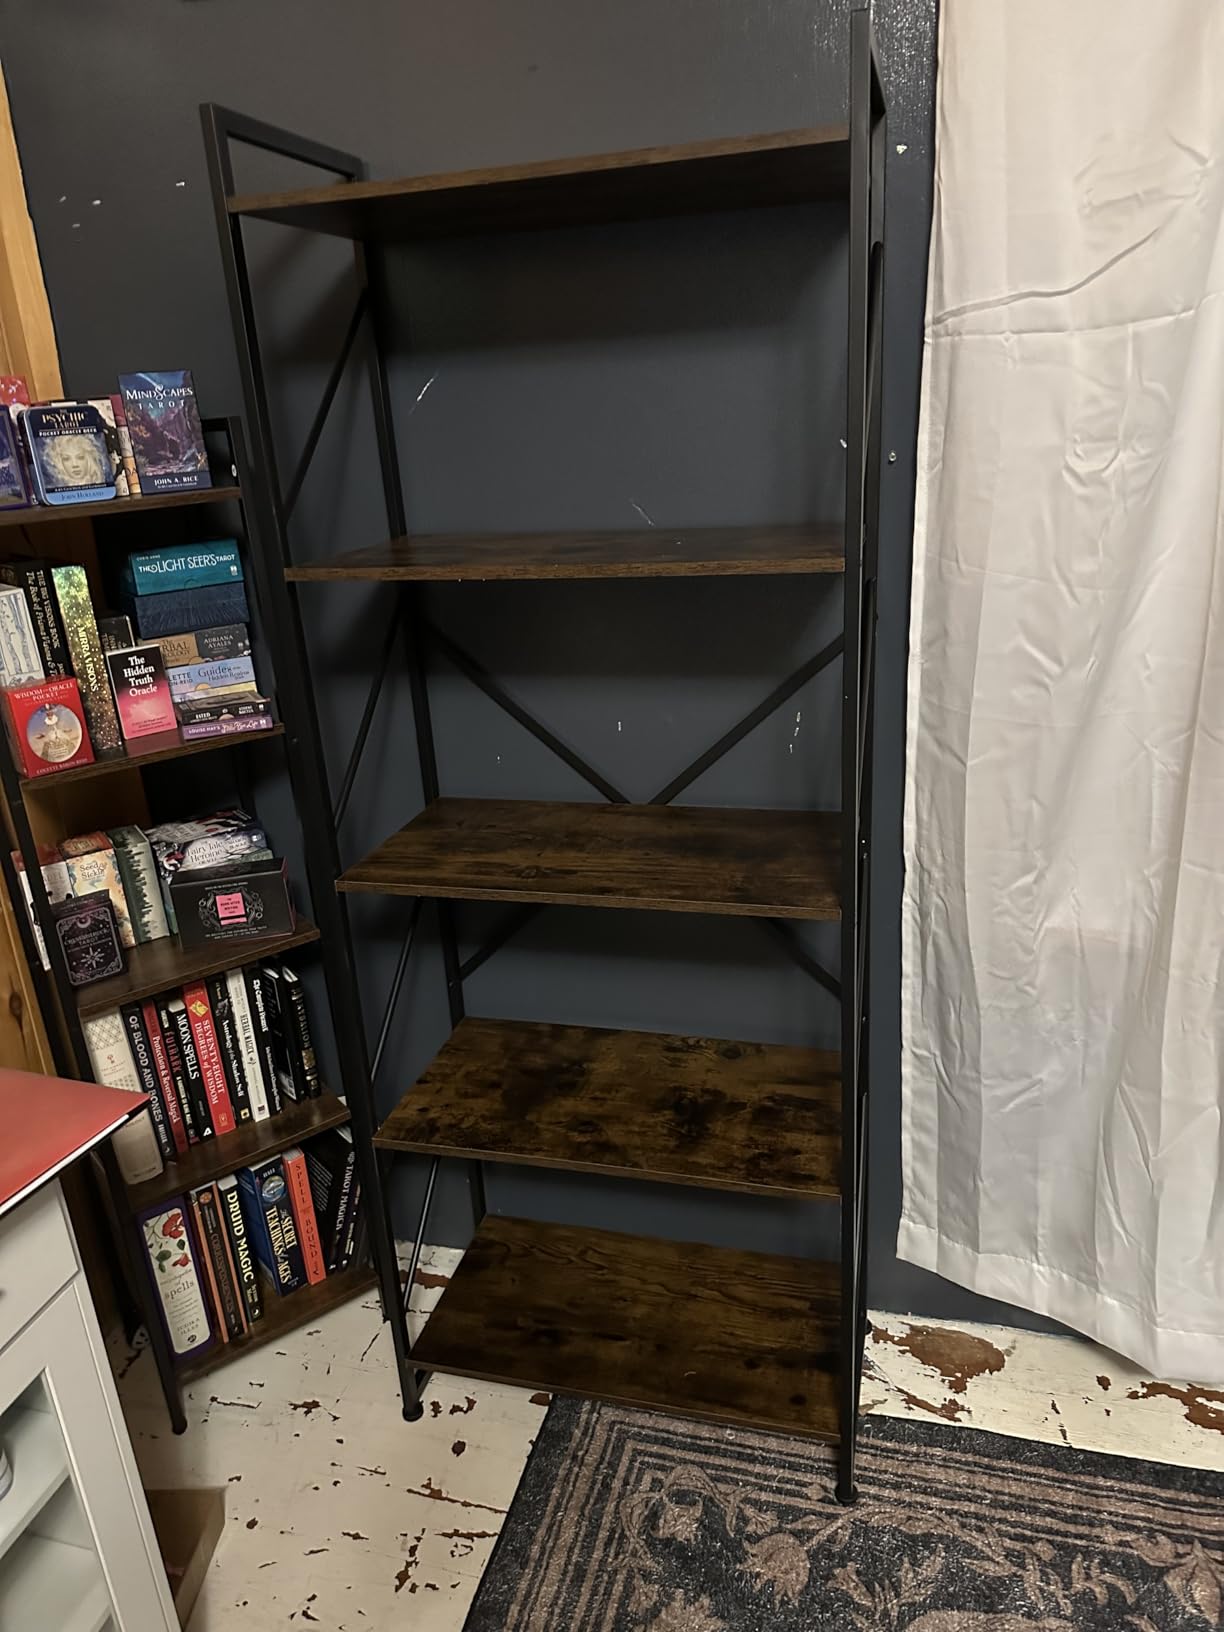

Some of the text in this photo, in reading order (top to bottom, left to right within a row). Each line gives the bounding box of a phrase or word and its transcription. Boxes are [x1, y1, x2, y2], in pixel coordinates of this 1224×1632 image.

[139, 400, 185, 410] TAROT
[41, 411, 86, 424] PSYCHIC
[154, 478, 173, 486] JOHN
[183, 475, 199, 483] RICE
[157, 558, 187, 574] LIGHT
[187, 554, 217, 569] SEER'S
[216, 554, 236, 562] TAROT
[161, 641, 188, 653] RBAL
[203, 634, 235, 644] ADRIANA
[207, 640, 232, 649] AYALES
[128, 655, 146, 667] The
[85, 657, 99, 693] VISIONS
[123, 665, 155, 679] Hidden
[128, 674, 154, 687] Truth
[168, 671, 192, 682] LETTE
[197, 665, 232, 678] Guides
[14, 688, 43, 700] WISDOM
[48, 682, 74, 693] ORACLE
[32, 692, 59, 701] POCKET
[129, 684, 158, 697] Oracle
[80, 860, 99, 872] Seed
[128, 1014, 140, 1030] OF
[133, 1030, 150, 1066] BLOOD
[176, 1013, 200, 1081] MOON SPELLS
[194, 1022, 208, 1059] DEGREES
[204, 1066, 219, 1106] WISDOM
[202, 1019, 226, 1095] SEVENTY-EIGHT
[142, 1066, 156, 1088] AND
[152, 1035, 167, 1070] Protection
[162, 1075, 175, 1102] Reversal
[147, 1088, 165, 1122] BONES
[226, 1190, 255, 1283] DRUID MAGIC
[281, 1215, 298, 1250] SECRET
[266, 1205, 286, 1258] TEACHINGS
[277, 1260, 293, 1284] AGES
[164, 1280, 195, 1300] spells
